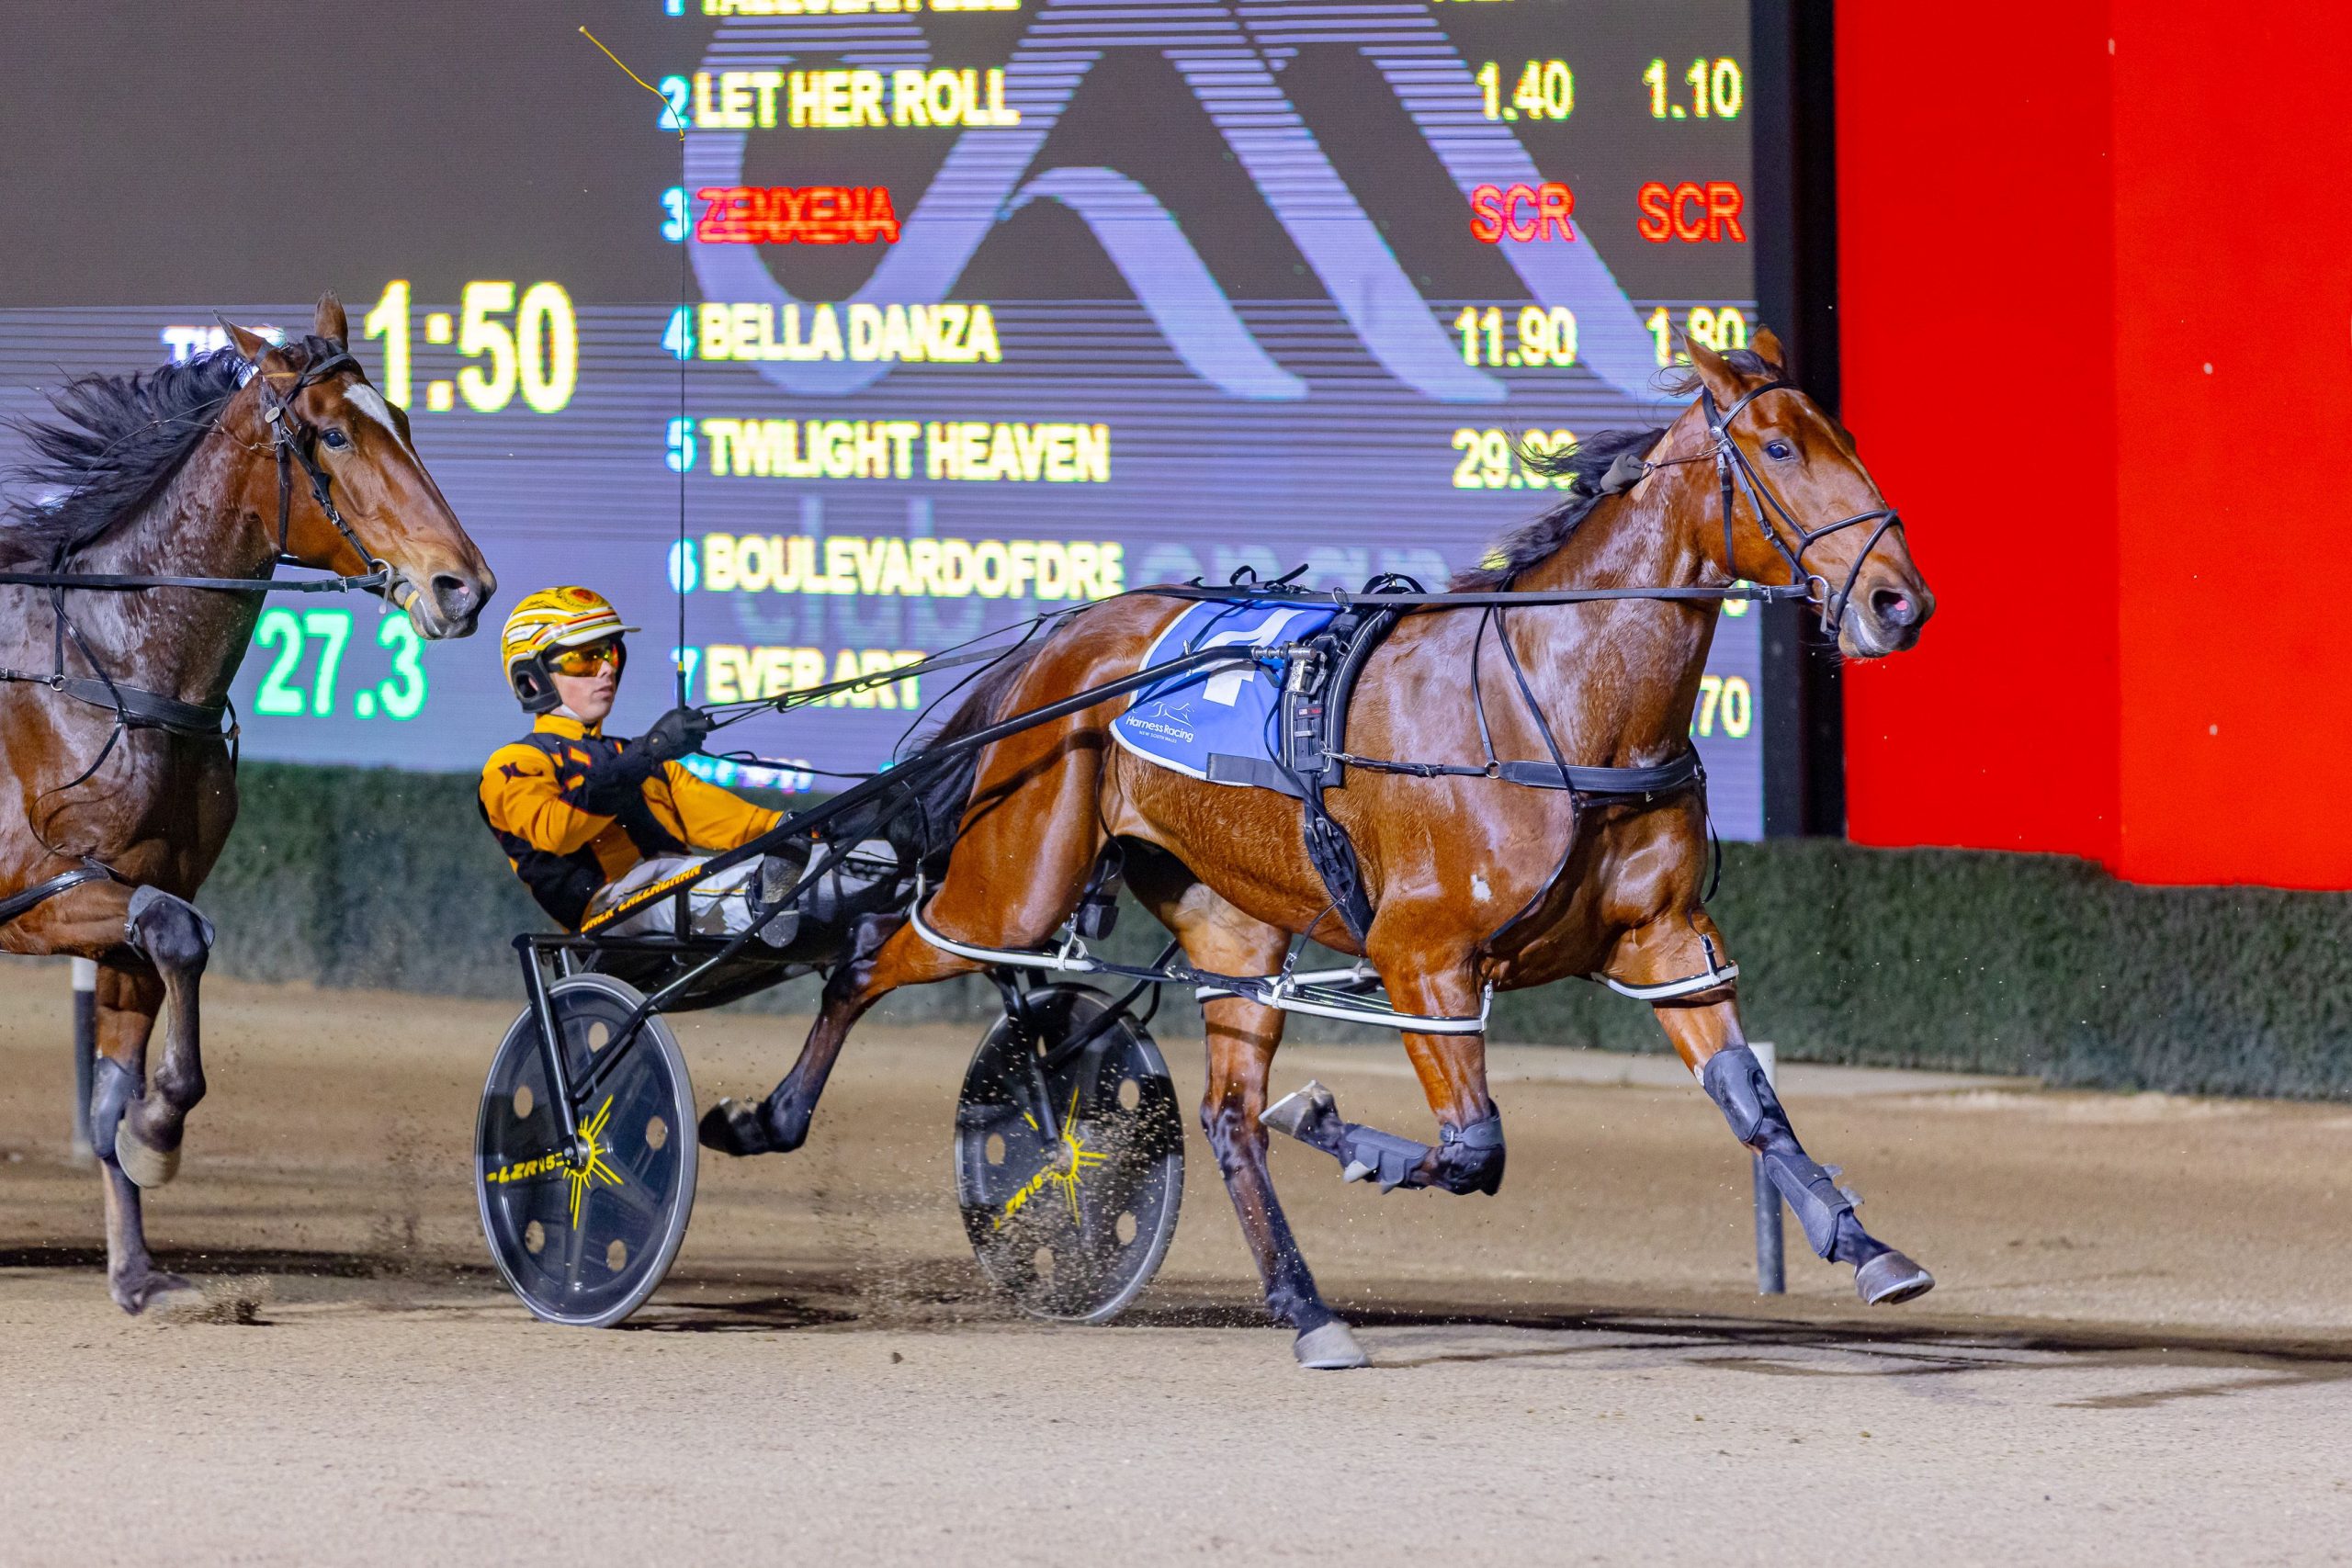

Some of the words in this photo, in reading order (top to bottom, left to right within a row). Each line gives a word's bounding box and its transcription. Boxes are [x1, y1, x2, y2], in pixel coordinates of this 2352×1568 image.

[657, 74, 691, 130] 2
[694, 70, 785, 129] LET
[787, 69, 888, 127] HER
[892, 67, 1022, 127] ROLL
[1475, 60, 1575, 121] 1.40
[1642, 57, 1744, 121] 1.10
[660, 186, 691, 242] 3
[1470, 182, 1577, 244] SCR
[1636, 181, 1747, 243] SCR
[365, 279, 579, 413] 1:50
[660, 304, 694, 359] 4
[697, 303, 845, 360] BELLA
[846, 304, 1003, 362] DANZA
[1454, 306, 1577, 367] 11.90
[664, 416, 697, 472] 5
[701, 418, 921, 479] TWILIGHT
[924, 422, 1112, 482] HEAVEN
[666, 537, 700, 593] 6
[254, 606, 429, 719] 27.3
[705, 644, 826, 706] EVER
[831, 648, 927, 710] ART
[1125, 716, 1164, 733] Harness
[1163, 724, 1194, 743] Racing
